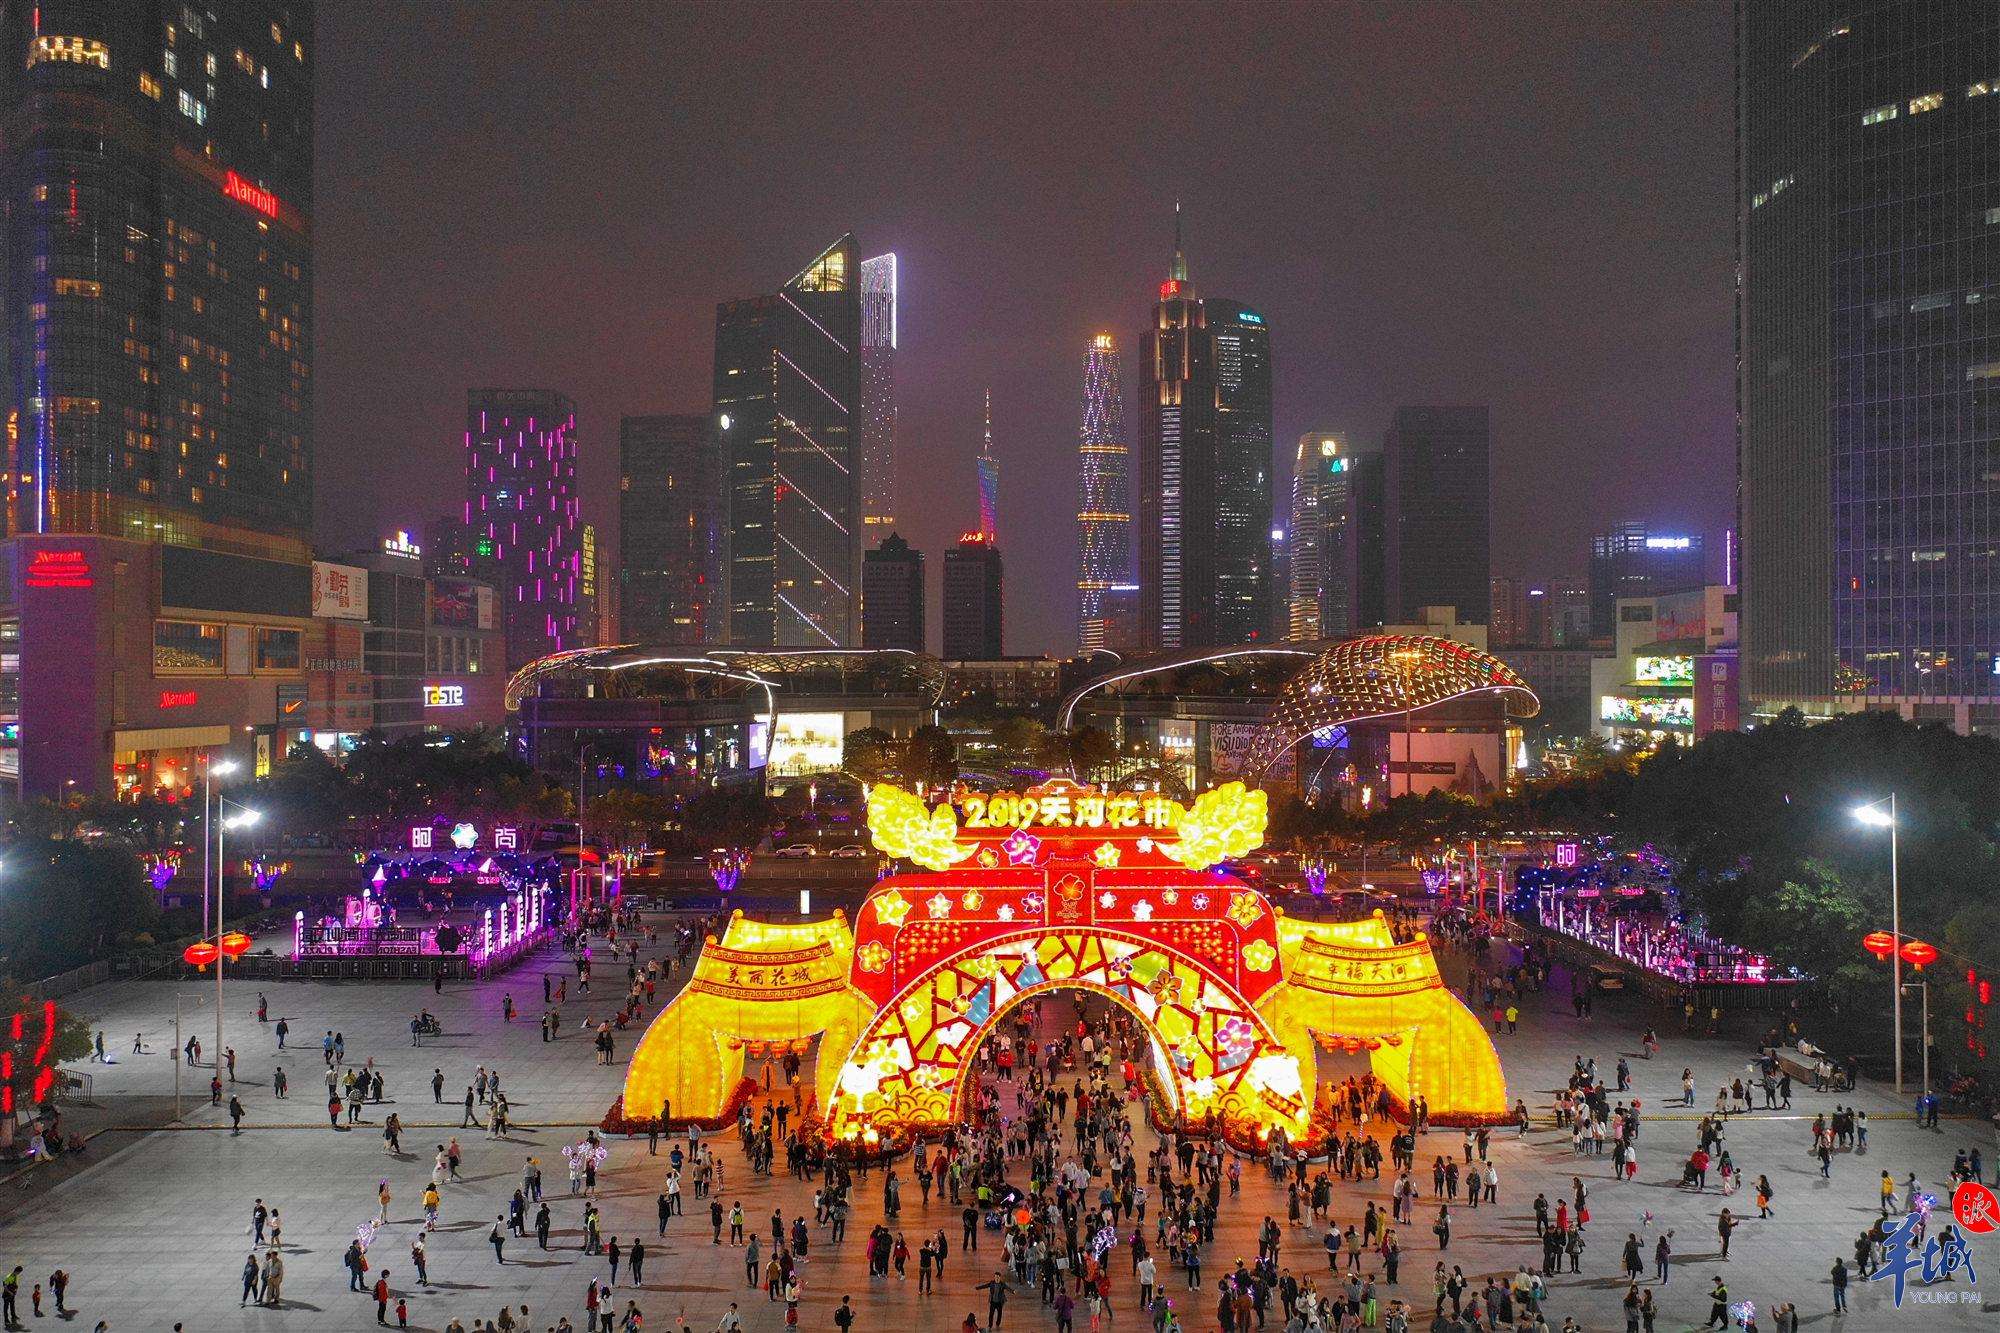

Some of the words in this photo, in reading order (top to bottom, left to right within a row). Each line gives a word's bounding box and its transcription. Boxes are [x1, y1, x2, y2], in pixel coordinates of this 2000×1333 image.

[224, 171, 279, 219] Marriott
[964, 796, 1170, 829] 2019天河花市
[412, 827, 432, 848] 时
[495, 828, 516, 849] 尚
[725, 966, 812, 986] 美丽花城
[1328, 960, 1407, 980] 幸福天河
